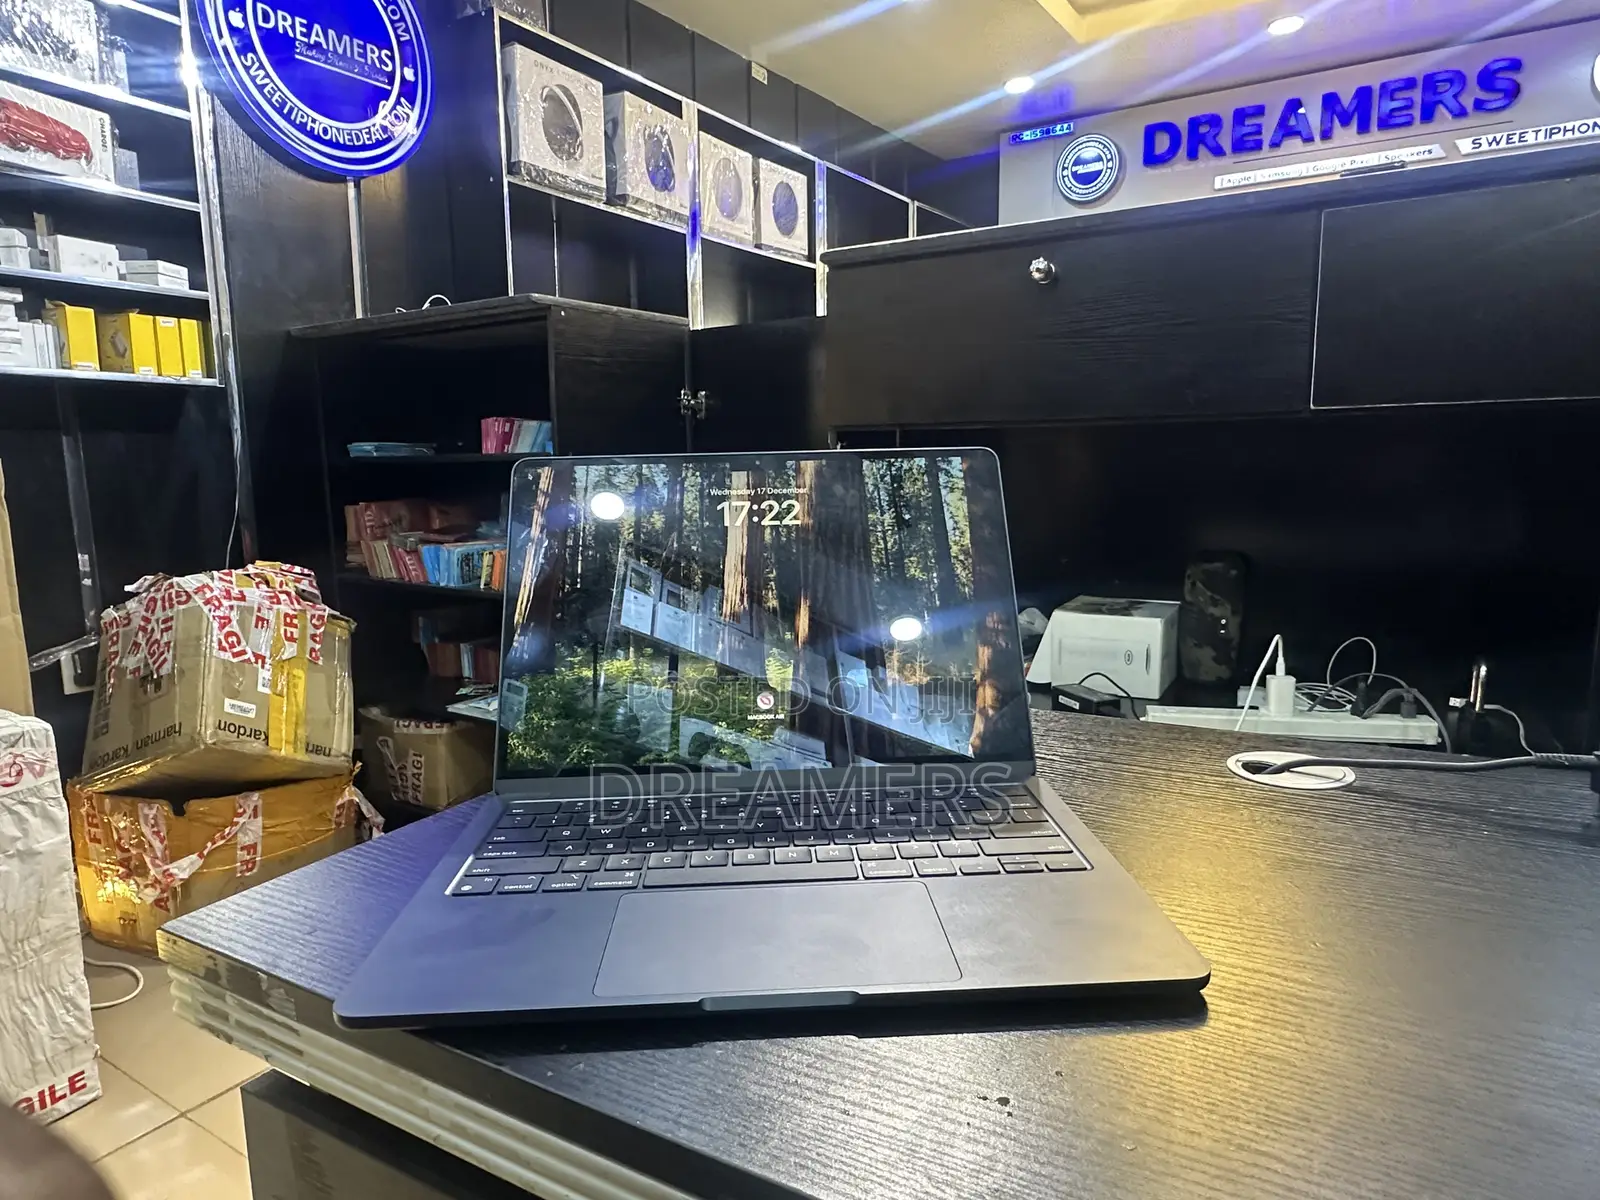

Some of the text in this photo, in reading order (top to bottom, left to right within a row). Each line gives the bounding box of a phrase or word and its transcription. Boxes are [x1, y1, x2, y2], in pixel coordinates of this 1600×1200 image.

[256, 2, 393, 72] DREAMERS
[534, 60, 554, 74] ONYX
[1143, 57, 1522, 167] DREAMERS
[1226, 175, 1252, 186] Apple
[1384, 148, 1433, 162] Spekers
[709, 487, 808, 497] Wednesday 17 December
[716, 500, 802, 526] 17:22
[136, 721, 182, 750] harman
[217, 719, 269, 746] kardon
